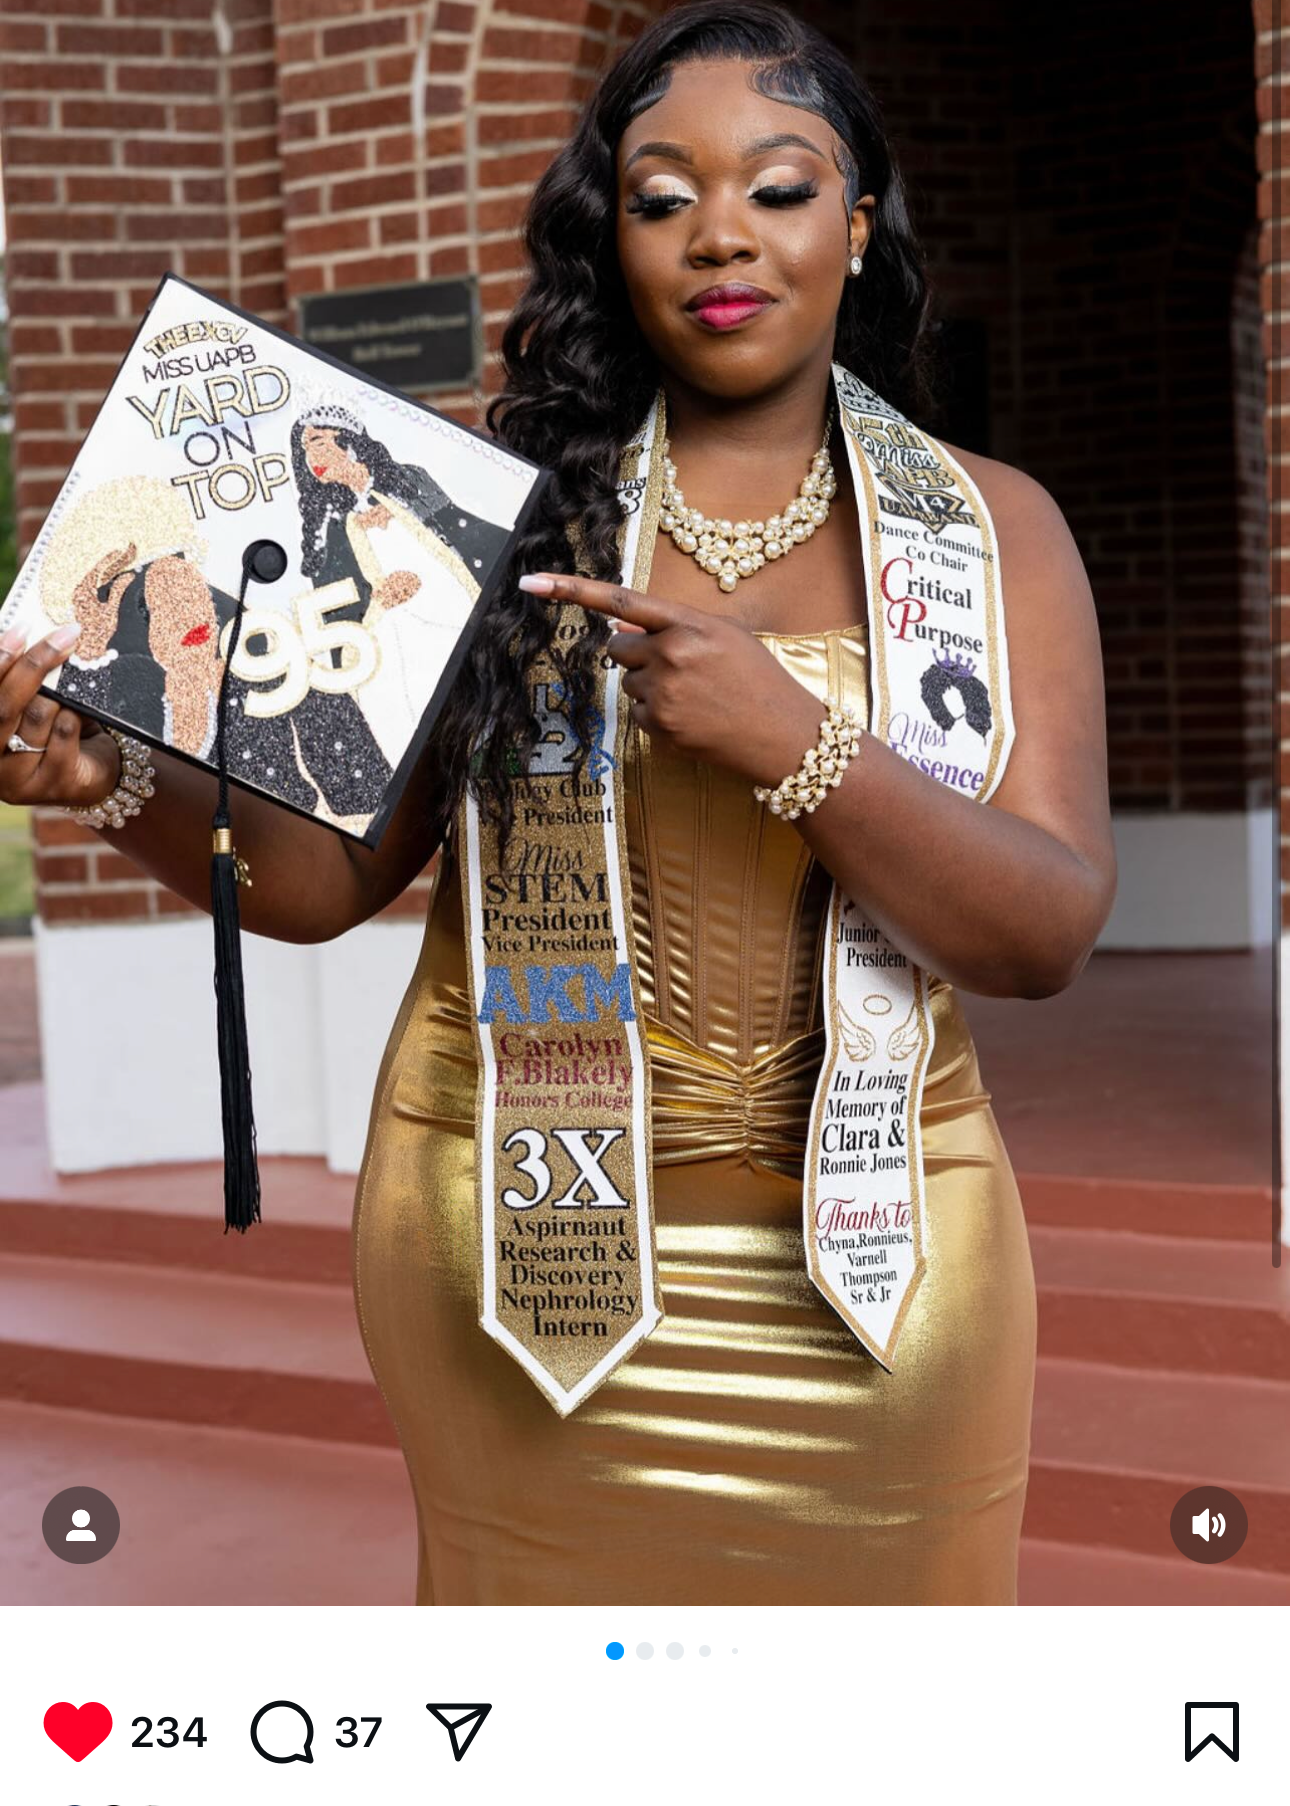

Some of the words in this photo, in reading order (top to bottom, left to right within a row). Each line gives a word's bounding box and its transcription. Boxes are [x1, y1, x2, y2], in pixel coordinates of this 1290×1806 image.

[142, 356, 194, 383] MISS
[194, 344, 257, 373] UAPB
[126, 365, 291, 440] YARD
[184, 421, 257, 467] ON
[170, 453, 290, 520] TOP
[873, 521, 919, 541] Dance
[923, 530, 994, 564] Committee
[905, 545, 926, 562] Co
[930, 551, 969, 574] Chair
[880, 557, 972, 610] Critical
[887, 595, 984, 654] Purpose
[219, 577, 382, 718] 95
[887, 711, 949, 756] Miss
[559, 778, 607, 799] Club
[523, 805, 614, 827] President
[485, 871, 608, 907] STEM
[481, 907, 612, 933] President
[836, 922, 881, 944] Junior
[482, 935, 523, 953] Vice
[528, 932, 620, 953] President
[846, 947, 907, 968] President
[477, 963, 637, 1026] AKM
[499, 1032, 623, 1064] Carolyn
[833, 1070, 851, 1092] In
[855, 1069, 909, 1095] Loving
[494, 1092, 560, 1109] Honors
[564, 1091, 634, 1113] College
[825, 1098, 888, 1122] Memory
[890, 1095, 907, 1117] of
[821, 1123, 881, 1154] Clara
[887, 1118, 907, 1148] &
[501, 1126, 631, 1211] 3X
[819, 1156, 868, 1176] Ronnie
[870, 1153, 907, 1173] Jones
[506, 1215, 627, 1243] Aspirnaut
[815, 1197, 888, 1241] Thanks
[888, 1200, 914, 1228] to
[500, 1240, 608, 1263] Research
[615, 1240, 638, 1262] &
[847, 1249, 888, 1268] Varnell
[510, 1264, 628, 1291] Discovery
[840, 1270, 898, 1288] Thompson
[501, 1288, 639, 1317] Nephrology
[850, 1290, 864, 1305] Sr
[866, 1288, 877, 1303] &
[880, 1286, 892, 1303] Jr
[533, 1314, 608, 1338] Intern
